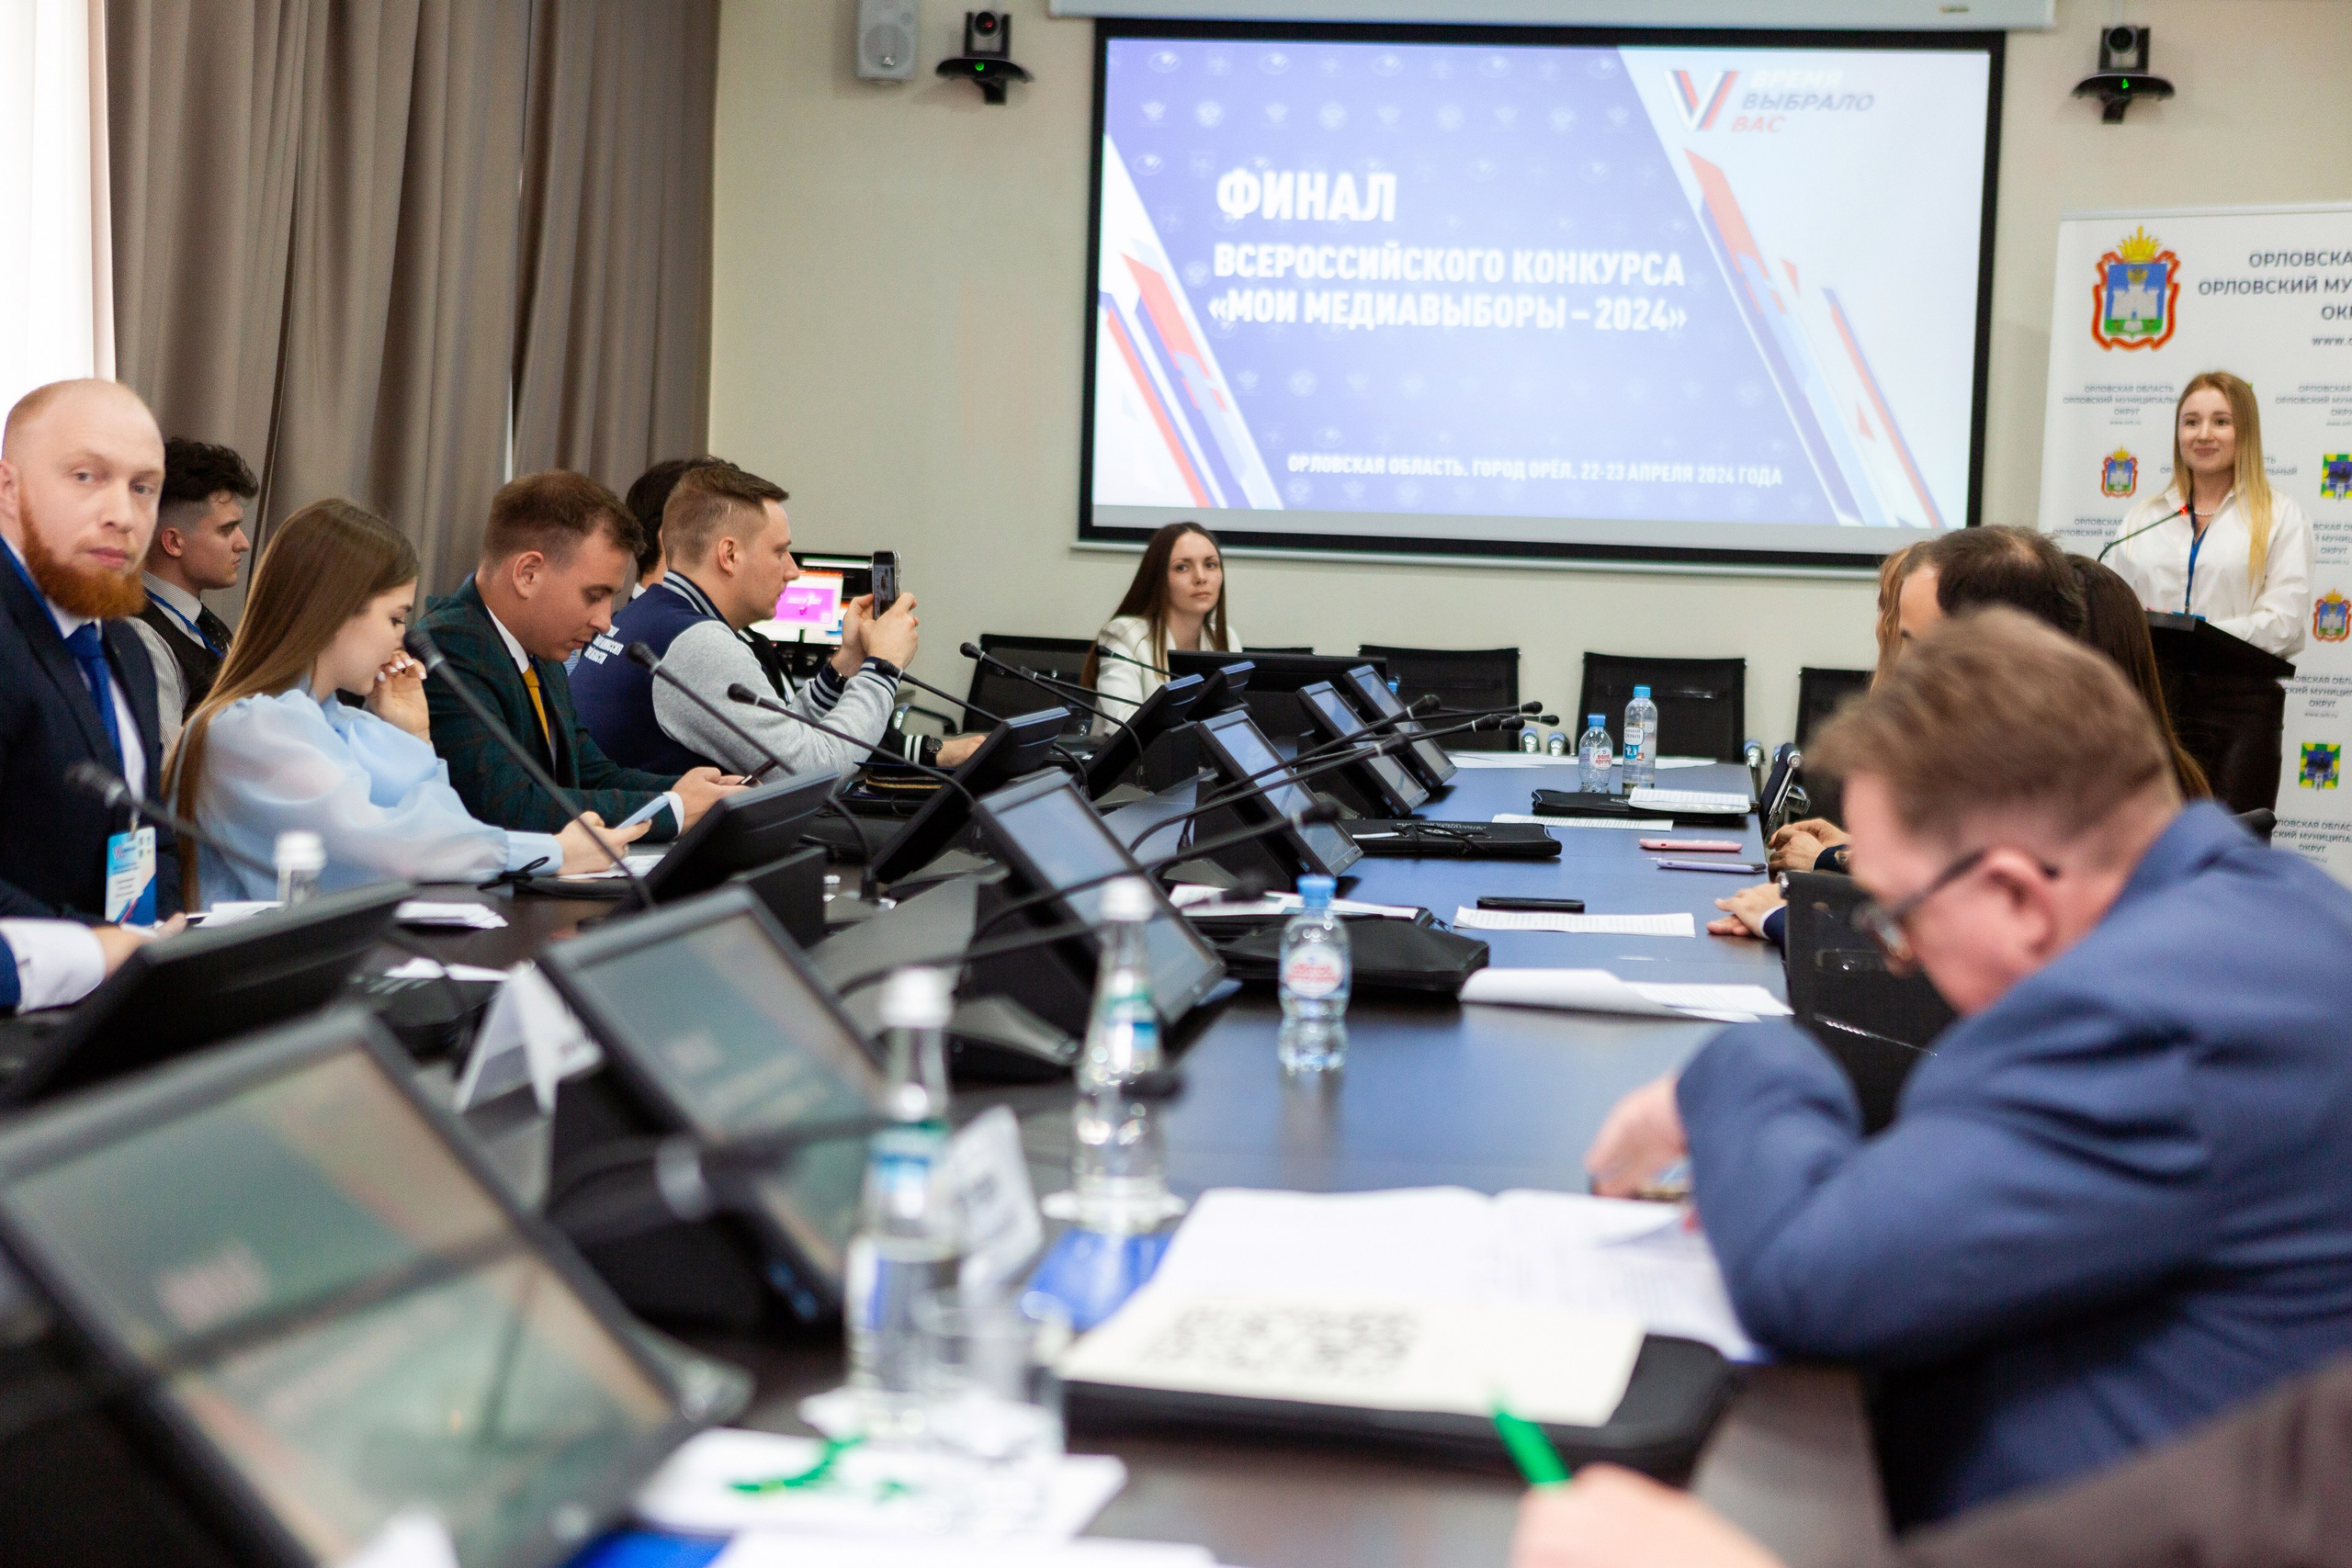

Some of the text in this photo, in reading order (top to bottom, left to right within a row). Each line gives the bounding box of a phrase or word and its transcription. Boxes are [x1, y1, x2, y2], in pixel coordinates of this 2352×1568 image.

[1742, 94, 1874, 111] ВЫБРАЛО
[1731, 116, 1785, 132] ВАС
[1216, 167, 1396, 221] ФИНАЛ
[1214, 241, 1685, 287] ВСЕРОССИЙСКОГО КОНКУРСА
[2199, 276, 2317, 295] ОРЛОВСКИЙ
[2321, 306, 2352, 321] ОК
[2063, 396, 2113, 404] ОРЛОВСКИЙ
[2276, 396, 2329, 404] ОРЛОВСКИЙ
[1287, 455, 1385, 474] ОРЛОВСКАЯ
[1473, 460, 1525, 480] ГОРОД
[1580, 462, 1624, 481] 22-23
[1627, 463, 1692, 483] АПРЕЛЯ
[1698, 466, 1734, 484] 2024
[1739, 467, 1782, 488] ГОДА
[2299, 844, 2326, 852] ОКРУГ
